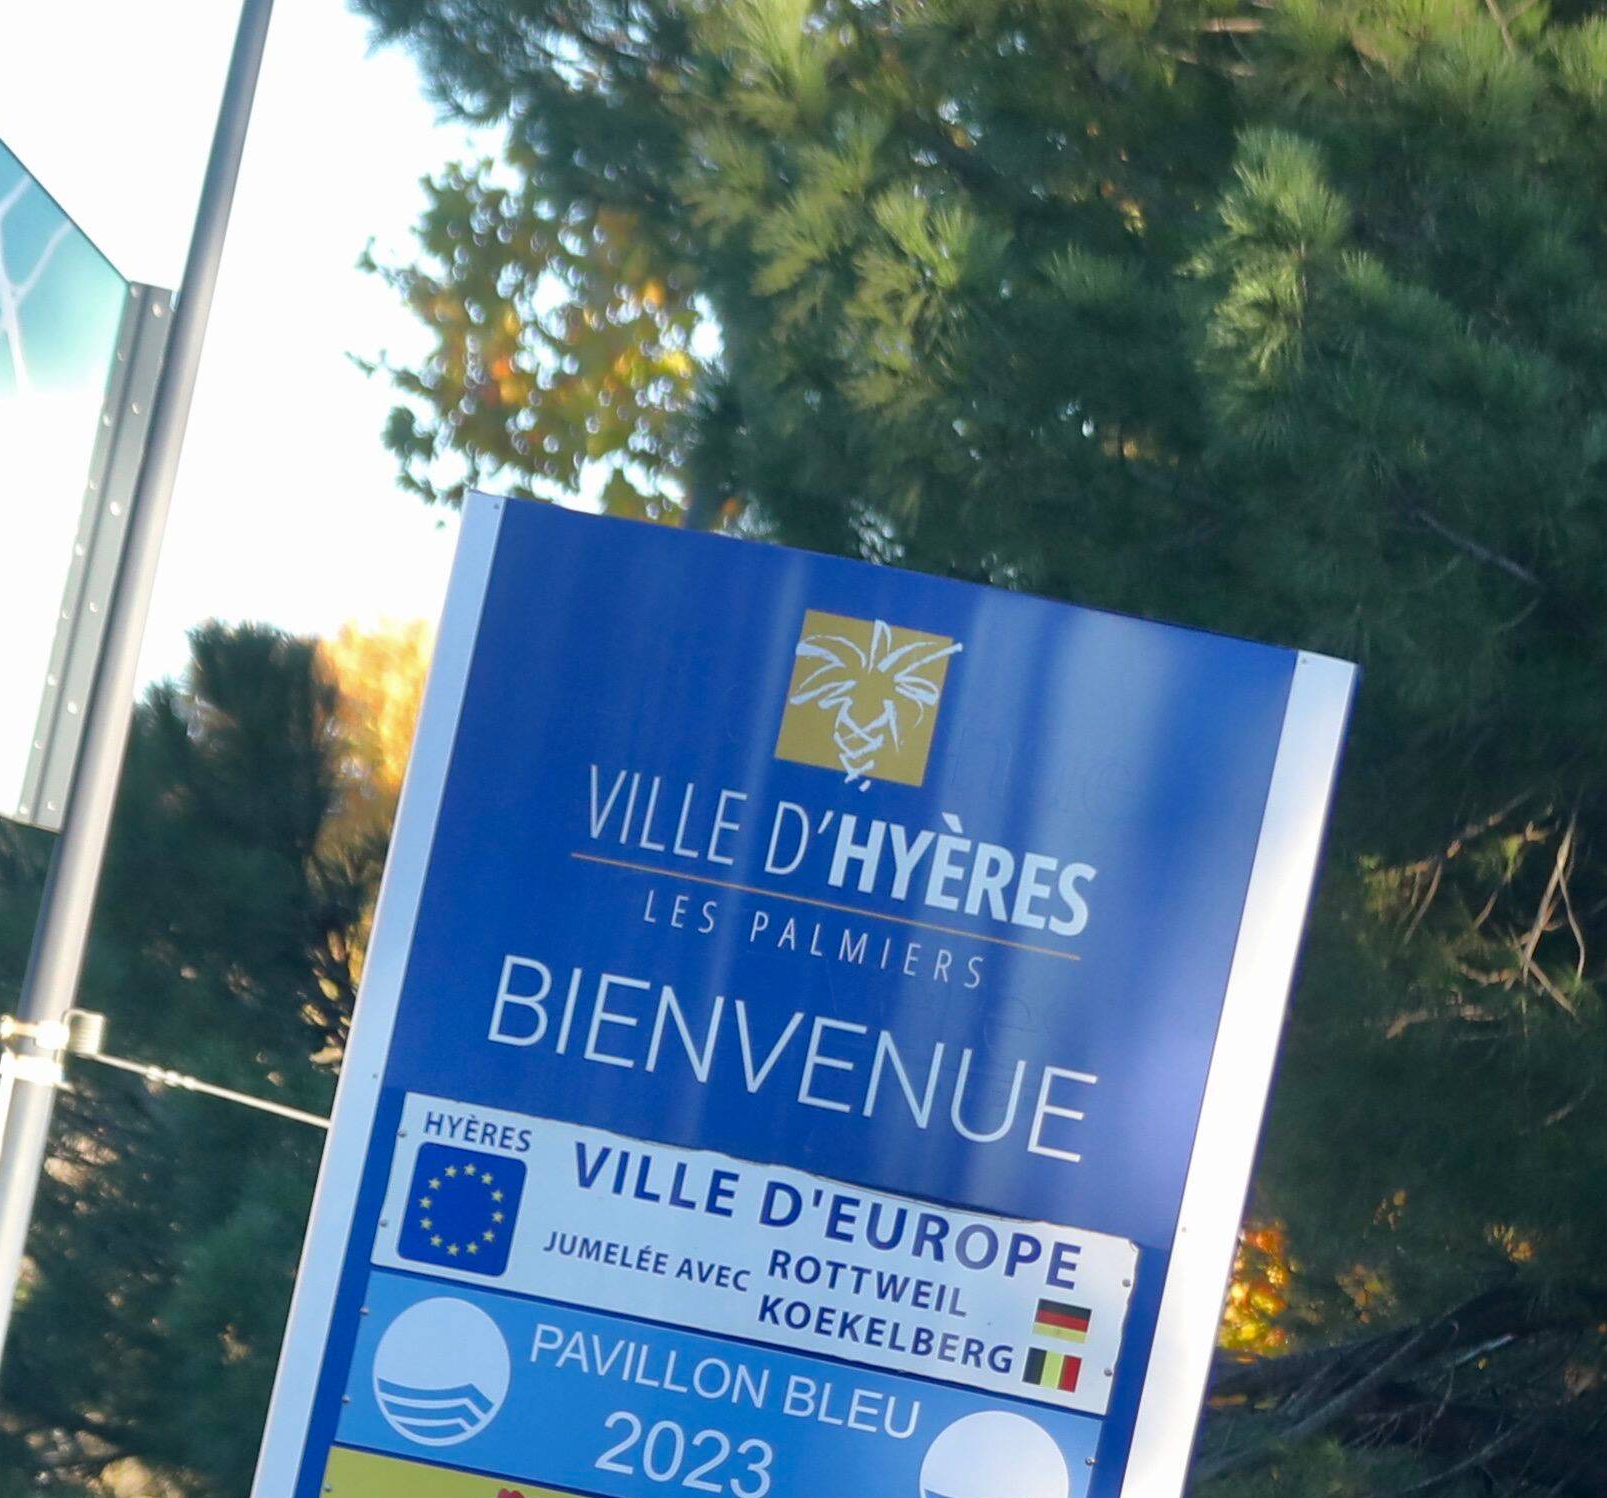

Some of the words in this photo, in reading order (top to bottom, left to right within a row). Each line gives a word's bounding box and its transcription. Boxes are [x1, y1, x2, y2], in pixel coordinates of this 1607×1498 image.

[590, 764, 747, 866] VILLE
[764, 801, 1098, 937] D'HYÈRES
[643, 889, 718, 934] LES
[750, 910, 984, 988] PALMIERS
[487, 955, 1098, 1164] BIENVENUE
[423, 1110, 533, 1153] HYÈRES
[573, 1142, 741, 1218] VILLE
[758, 1179, 1083, 1292] D'EUROPE
[542, 1230, 669, 1277] JUMELÉE
[675, 1258, 751, 1292] AVEC
[767, 1249, 967, 1319] ROTTWEIL
[529, 1323, 770, 1409] PAVILLON
[783, 1374, 921, 1440] BLEU
[757, 1294, 1015, 1374] KOEKELBERG
